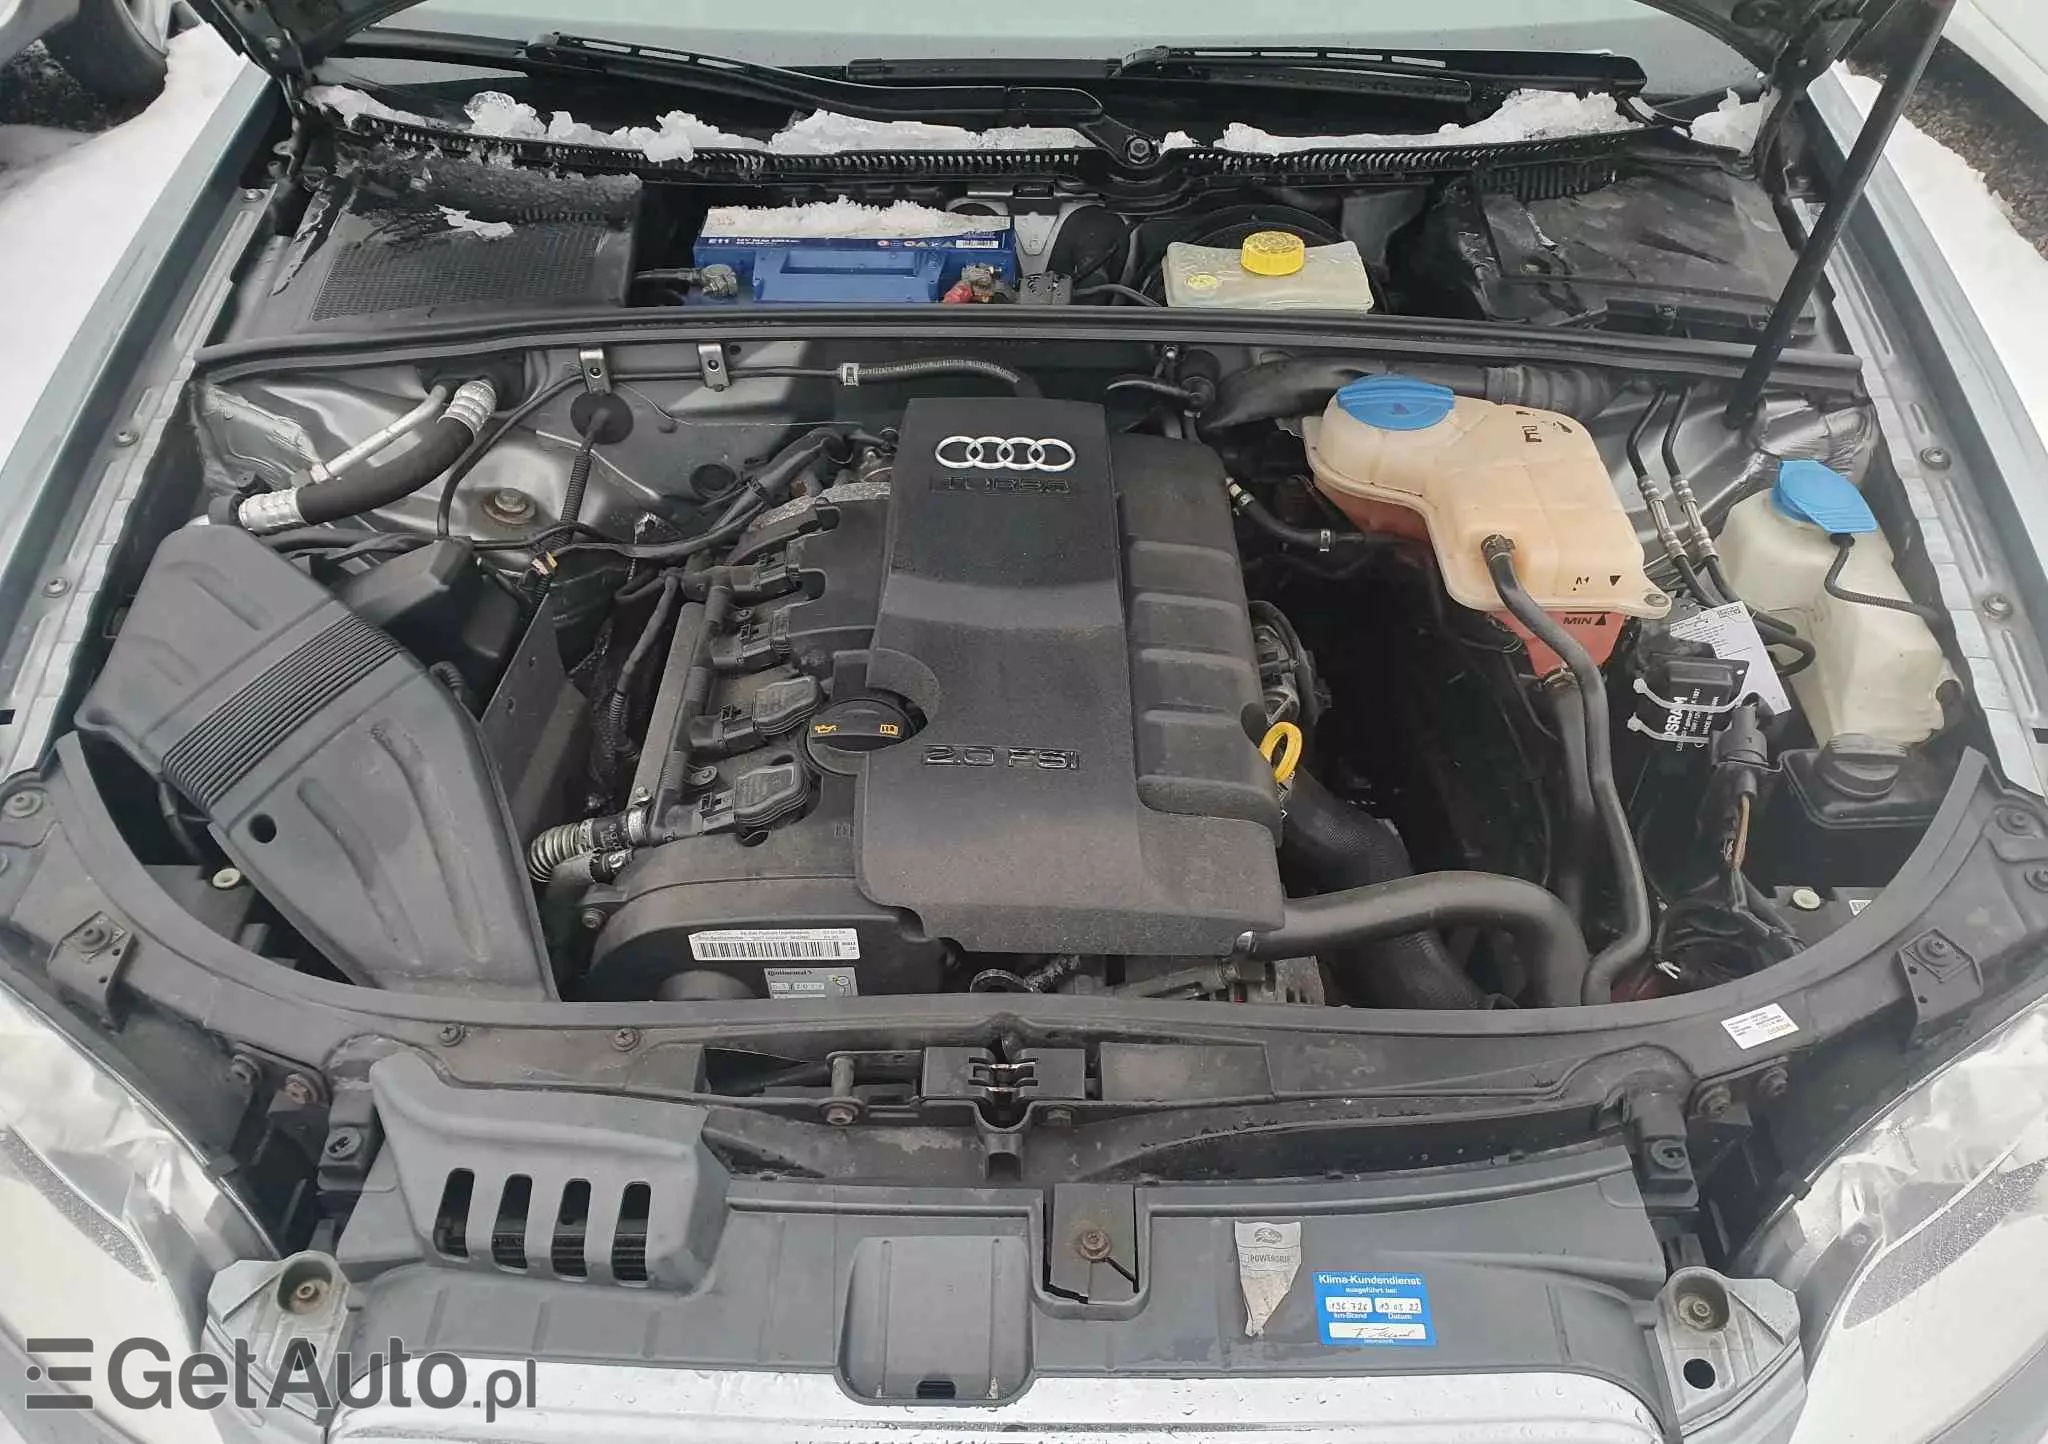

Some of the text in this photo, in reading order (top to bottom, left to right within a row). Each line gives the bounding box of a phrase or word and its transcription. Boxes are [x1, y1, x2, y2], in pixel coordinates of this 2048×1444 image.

[1562, 616, 1593, 625] MIN
[921, 745, 1080, 769] 2.0 FSI
[1318, 1274, 1422, 1286] Klima-Kundendienst
